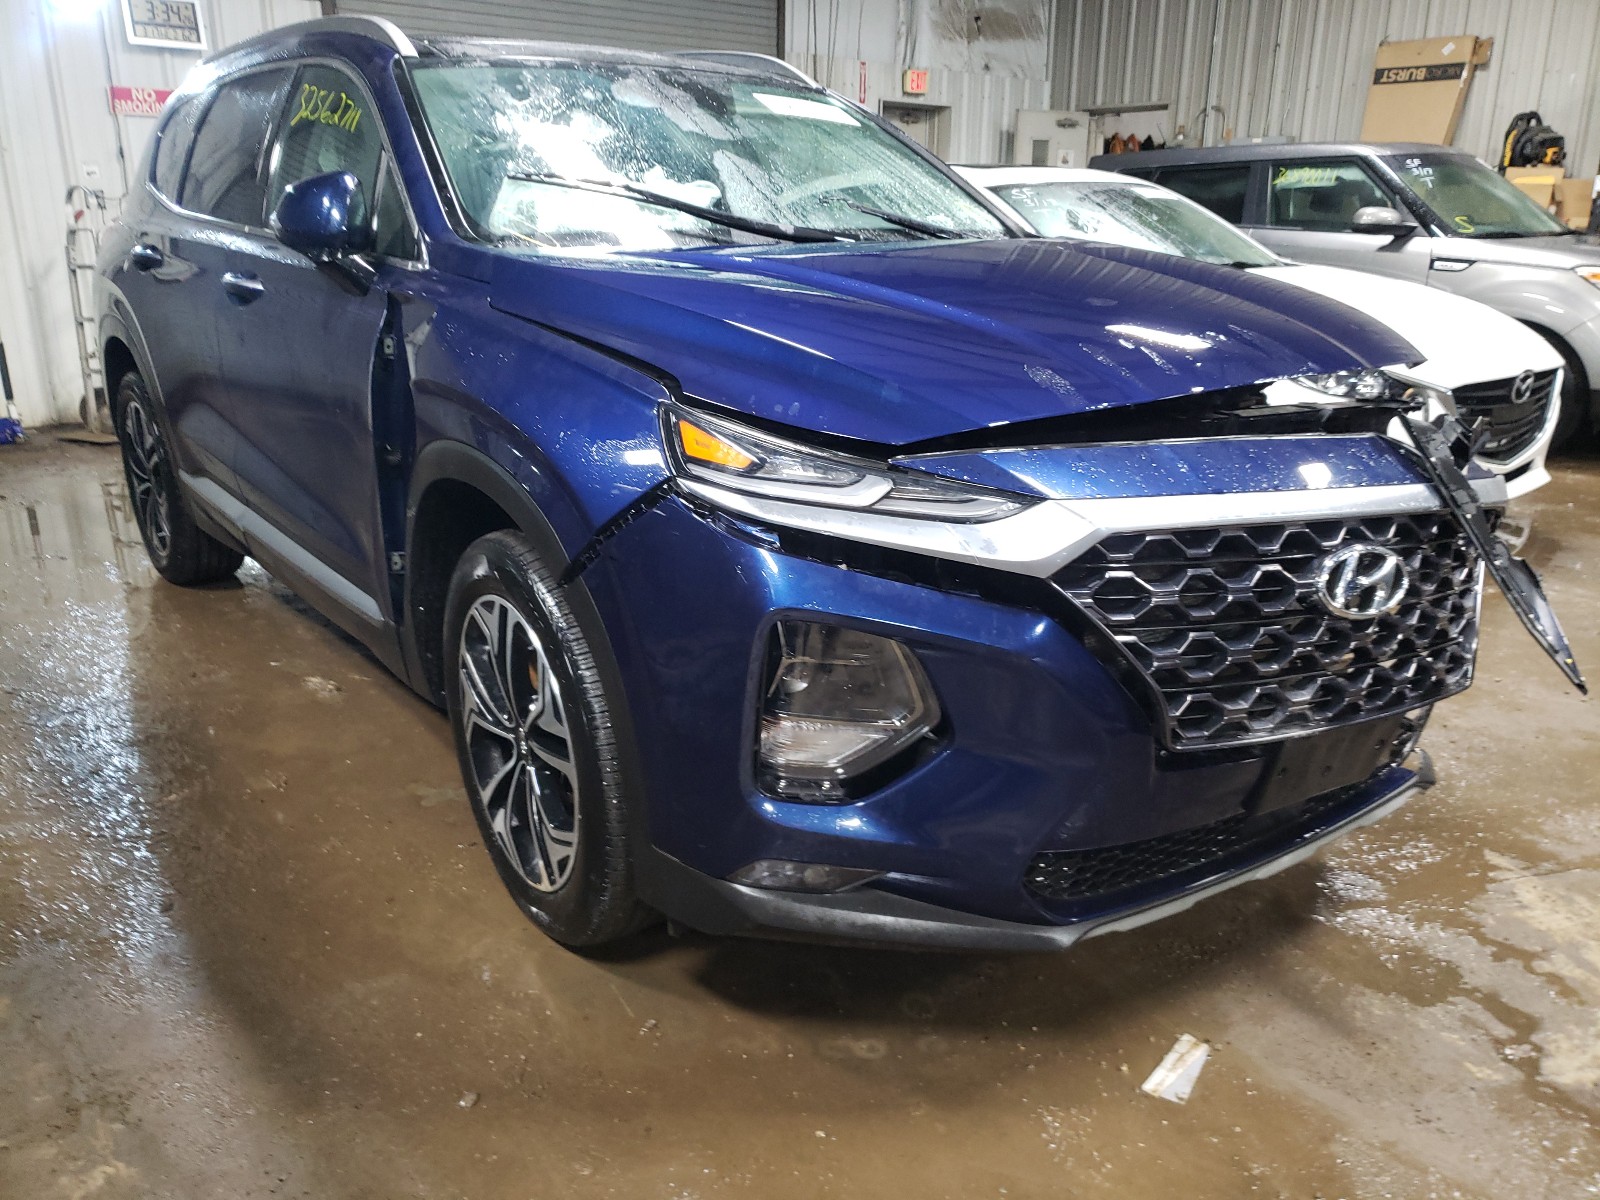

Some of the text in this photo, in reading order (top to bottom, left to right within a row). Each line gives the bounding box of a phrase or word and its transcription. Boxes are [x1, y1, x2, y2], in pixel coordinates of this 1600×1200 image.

[910, 69, 928, 92] EXIT
[1380, 67, 1427, 83] BURST
[131, 87, 157, 101] NO
[114, 99, 164, 114] SMOKIN
[1454, 215, 1475, 234] S
